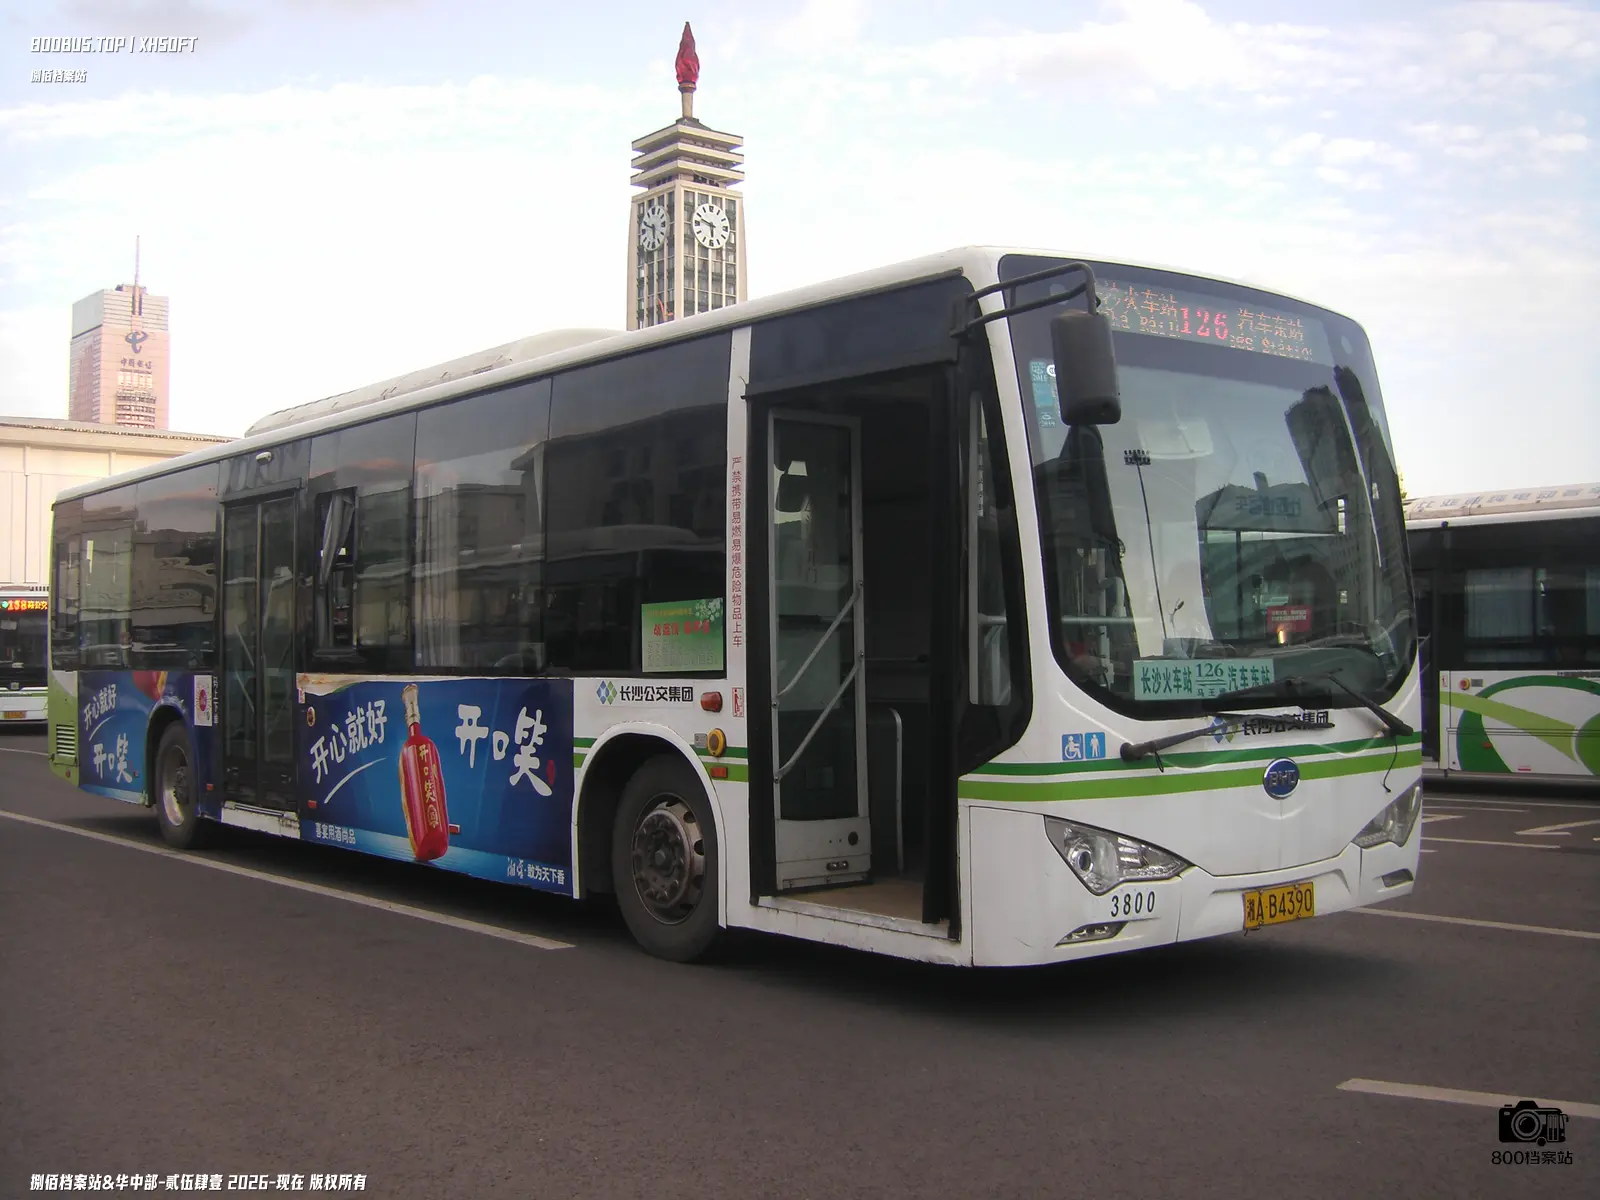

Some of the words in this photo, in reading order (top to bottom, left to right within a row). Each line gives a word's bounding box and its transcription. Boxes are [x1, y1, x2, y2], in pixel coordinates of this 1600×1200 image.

[1180, 307, 1229, 340] 126
[731, 456, 743, 648] 严禁携带易燃易爆危险物品上车
[1140, 666, 1193, 695] 长沙火车站
[1227, 664, 1271, 692] 汽车东站
[1196, 662, 1224, 678] 126
[83, 682, 118, 732] 开心就好
[619, 686, 694, 702] 长沙公交集团
[93, 732, 133, 784] 开口笑
[310, 699, 388, 784] 开心就好
[455, 703, 553, 797] 开口笑
[1111, 890, 1155, 917] 3800
